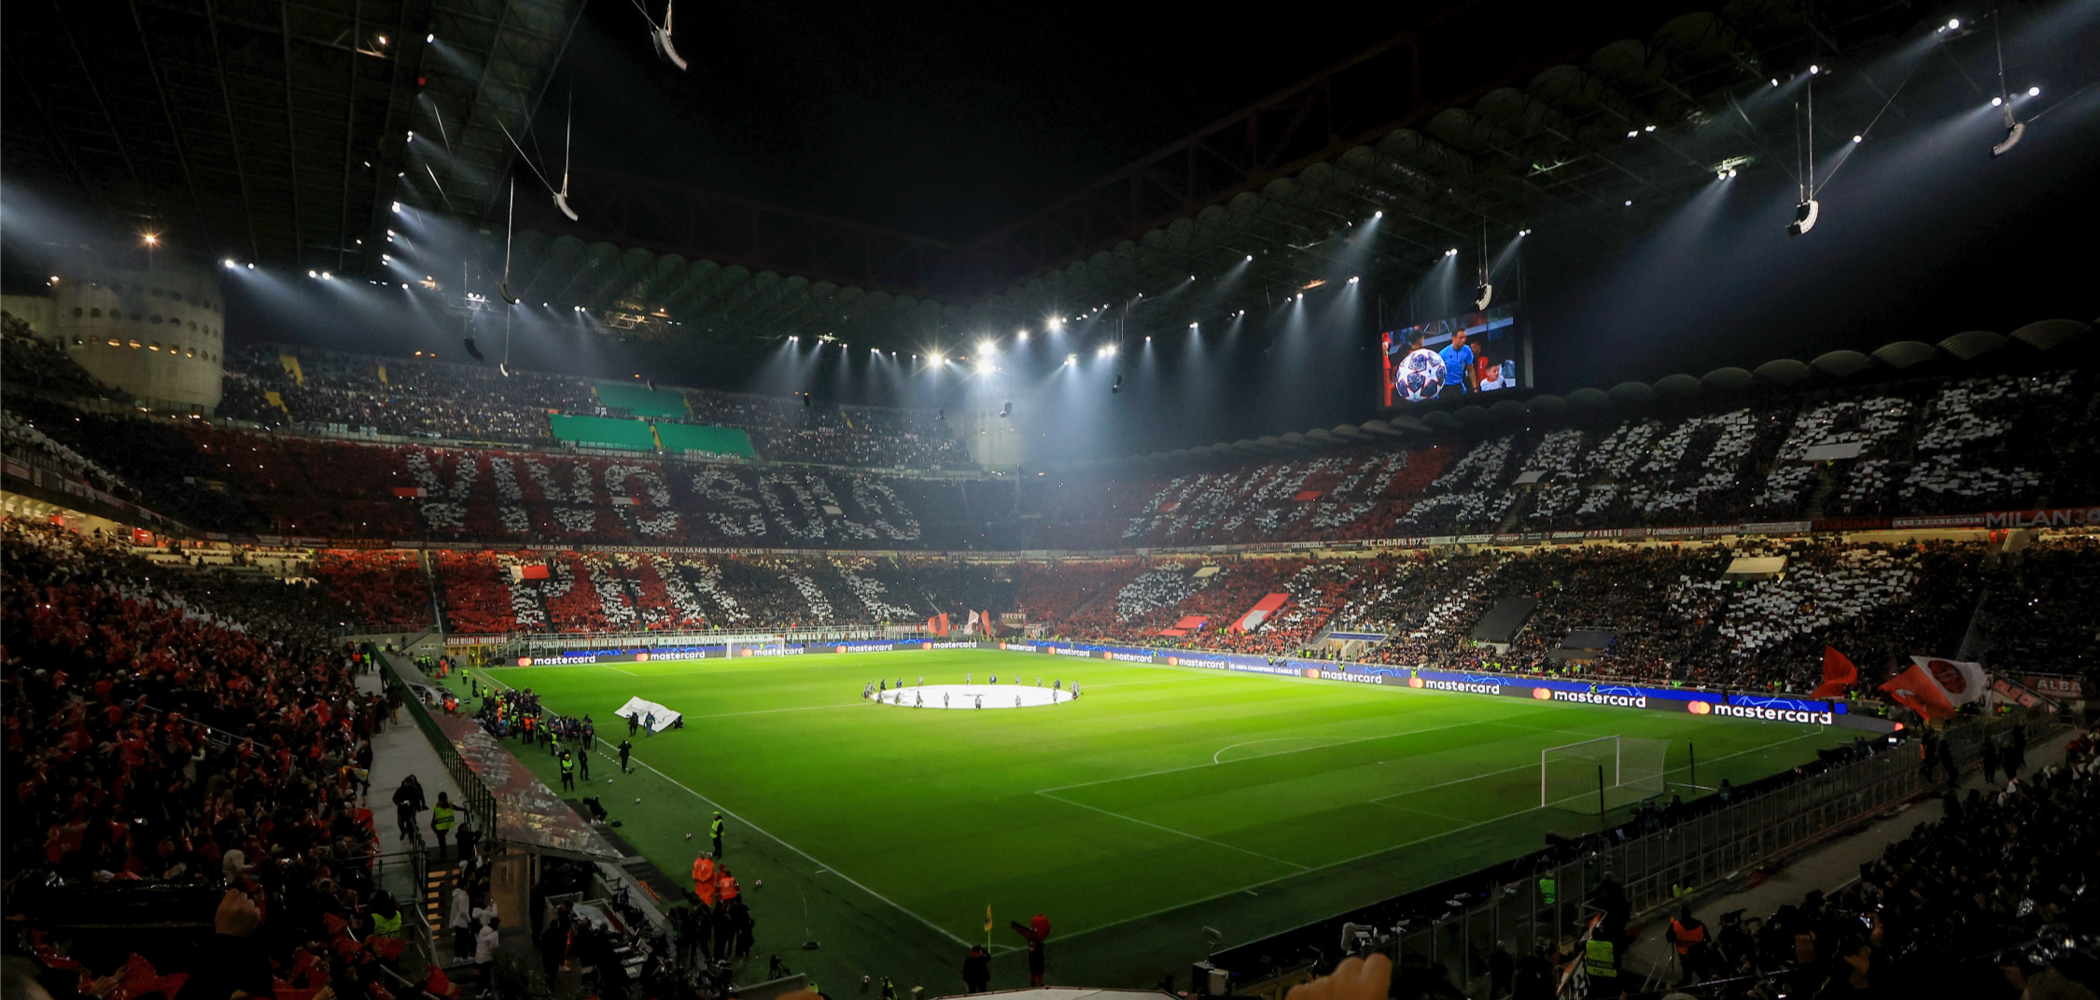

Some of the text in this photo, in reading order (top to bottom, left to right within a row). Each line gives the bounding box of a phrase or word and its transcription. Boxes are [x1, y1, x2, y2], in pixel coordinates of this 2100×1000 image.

[1985, 509, 2072, 528] MILAN
[590, 545, 664, 553] ASSOCIAZIONE
[666, 546, 708, 554] ITALIANA
[847, 643, 893, 653] mastercard
[933, 641, 976, 649] mastercard
[1006, 643, 1036, 652] mastercard
[650, 651, 705, 660] mastercard
[754, 646, 804, 656] mastercard
[534, 655, 596, 665] mastercard
[1112, 652, 1152, 663] mastercard
[1178, 658, 1224, 669] mastercard
[1248, 665, 1274, 673] CHAMPIONS
[1275, 667, 1293, 675] LEAGUE
[1321, 671, 1382, 684] mastercard
[1426, 680, 1500, 695] mastercard
[2037, 679, 2082, 692] ALBA
[1554, 690, 1646, 708] mastercard
[1714, 704, 1832, 725] mastercard
